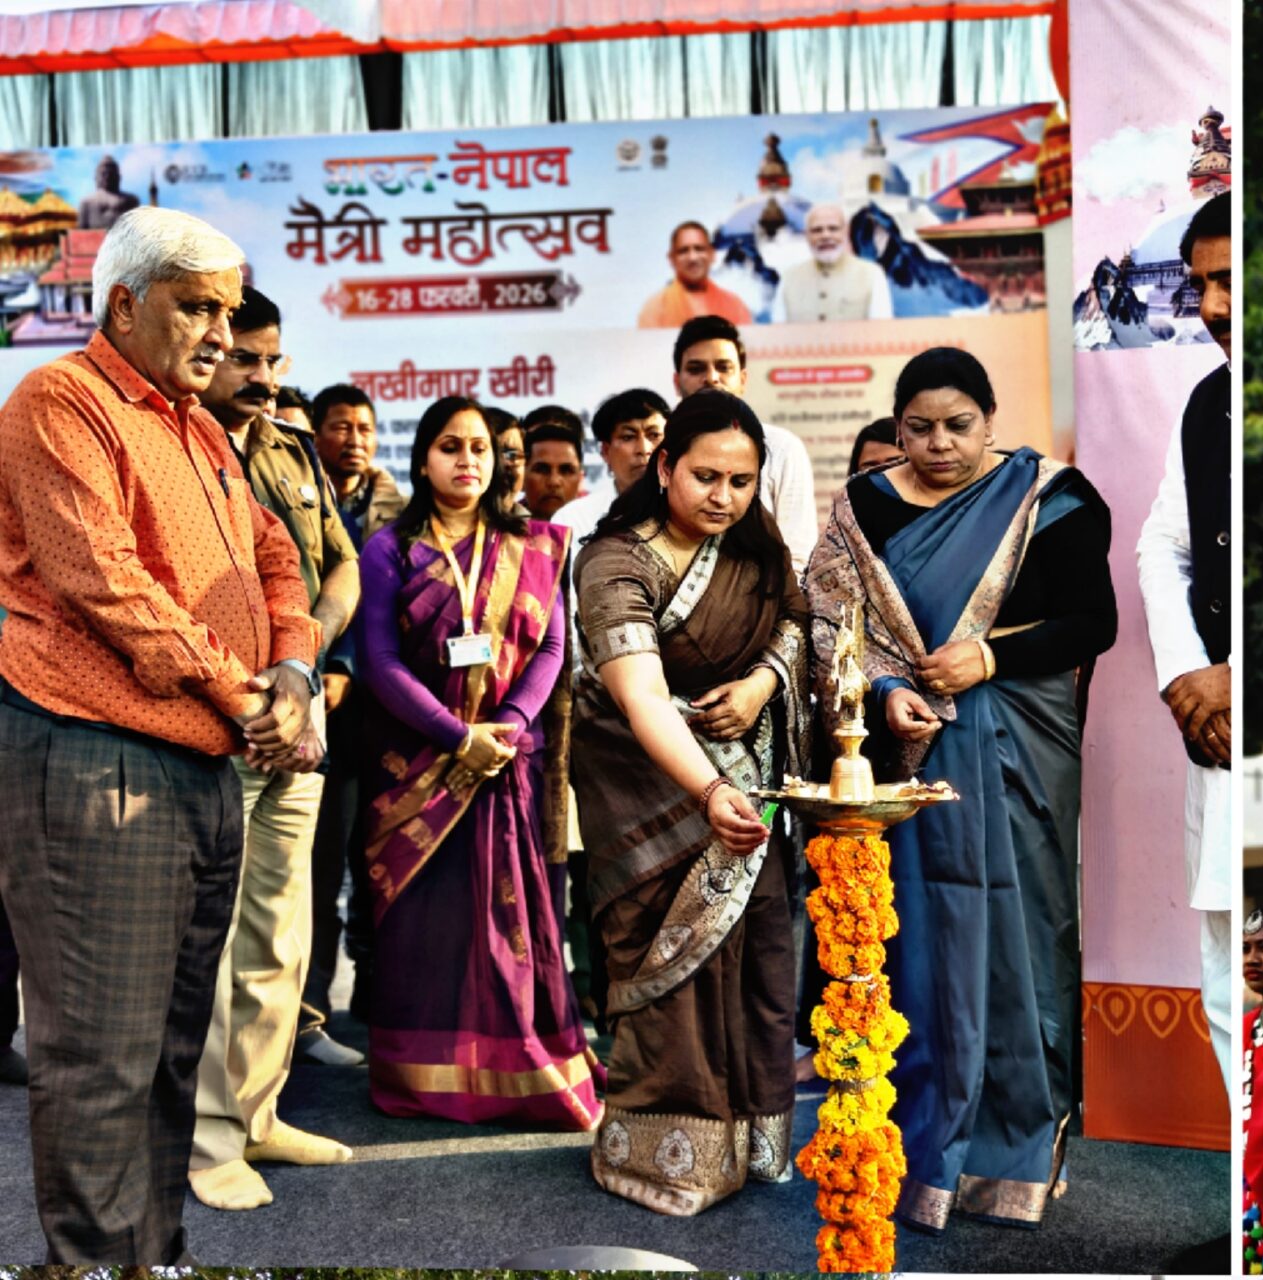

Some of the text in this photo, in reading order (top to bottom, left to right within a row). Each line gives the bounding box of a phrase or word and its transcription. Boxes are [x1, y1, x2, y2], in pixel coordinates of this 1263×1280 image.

[284, 195, 614, 266] मैत्री महोत्सव
[495, 283, 548, 306] 2026
[349, 353, 556, 402] लखीमपर खीरी
